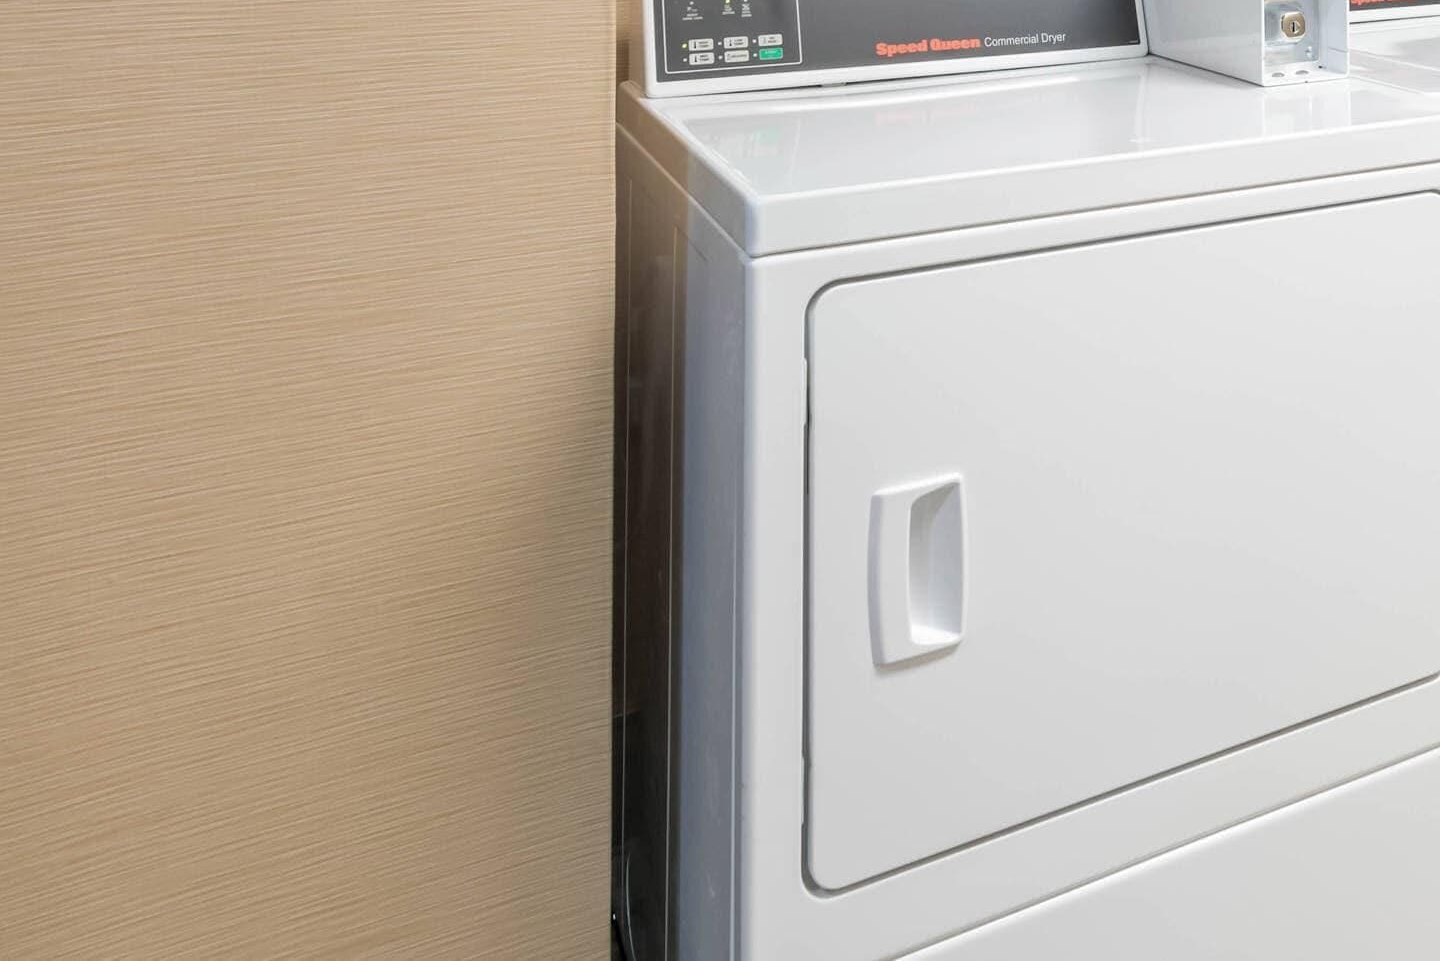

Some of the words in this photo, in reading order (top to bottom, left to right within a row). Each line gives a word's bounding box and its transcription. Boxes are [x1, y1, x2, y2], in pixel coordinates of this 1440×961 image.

[875, 40, 928, 58] Speed
[929, 37, 981, 52] Queen
[984, 33, 1039, 48] Commercial
[1041, 31, 1067, 45] Dryer
